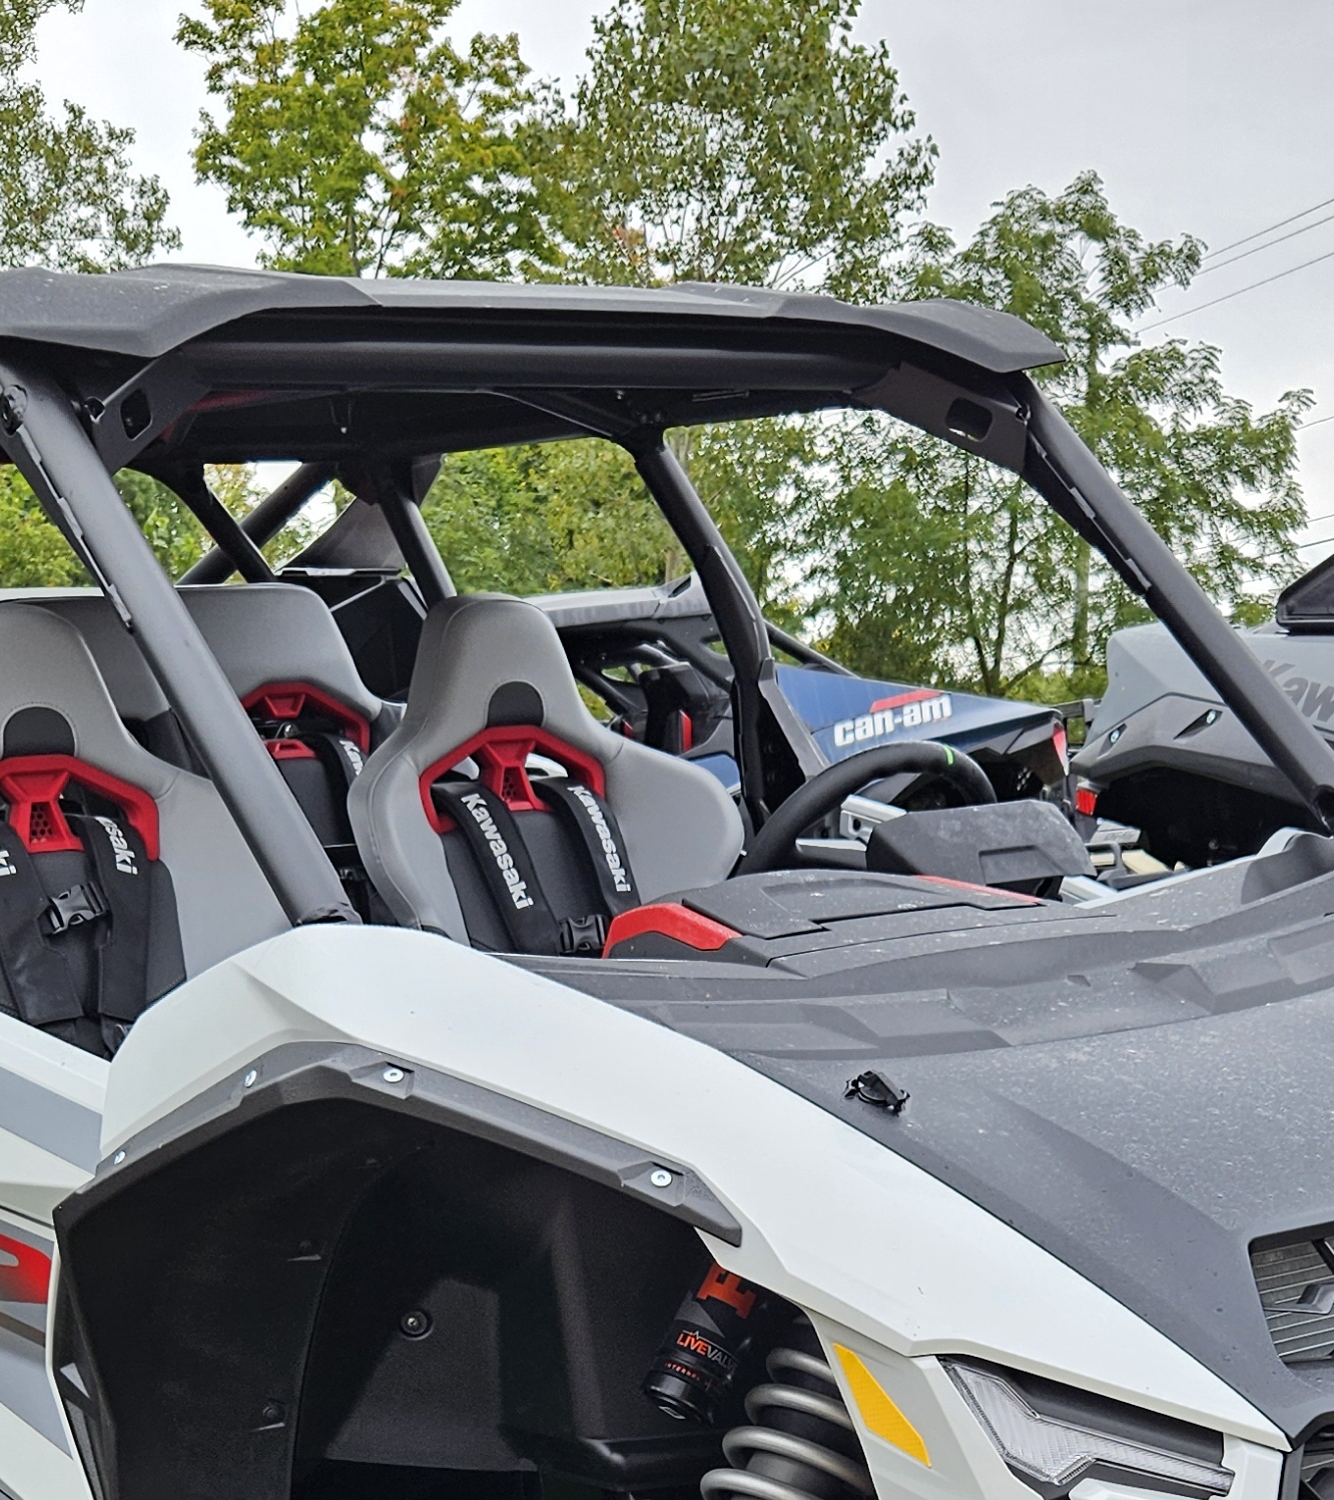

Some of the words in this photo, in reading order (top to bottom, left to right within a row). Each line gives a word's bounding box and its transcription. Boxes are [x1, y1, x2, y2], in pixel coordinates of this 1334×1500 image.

[833, 694, 952, 747] can-am
[461, 793, 534, 909] Kawasaki
[568, 785, 631, 892] Kawasaki
